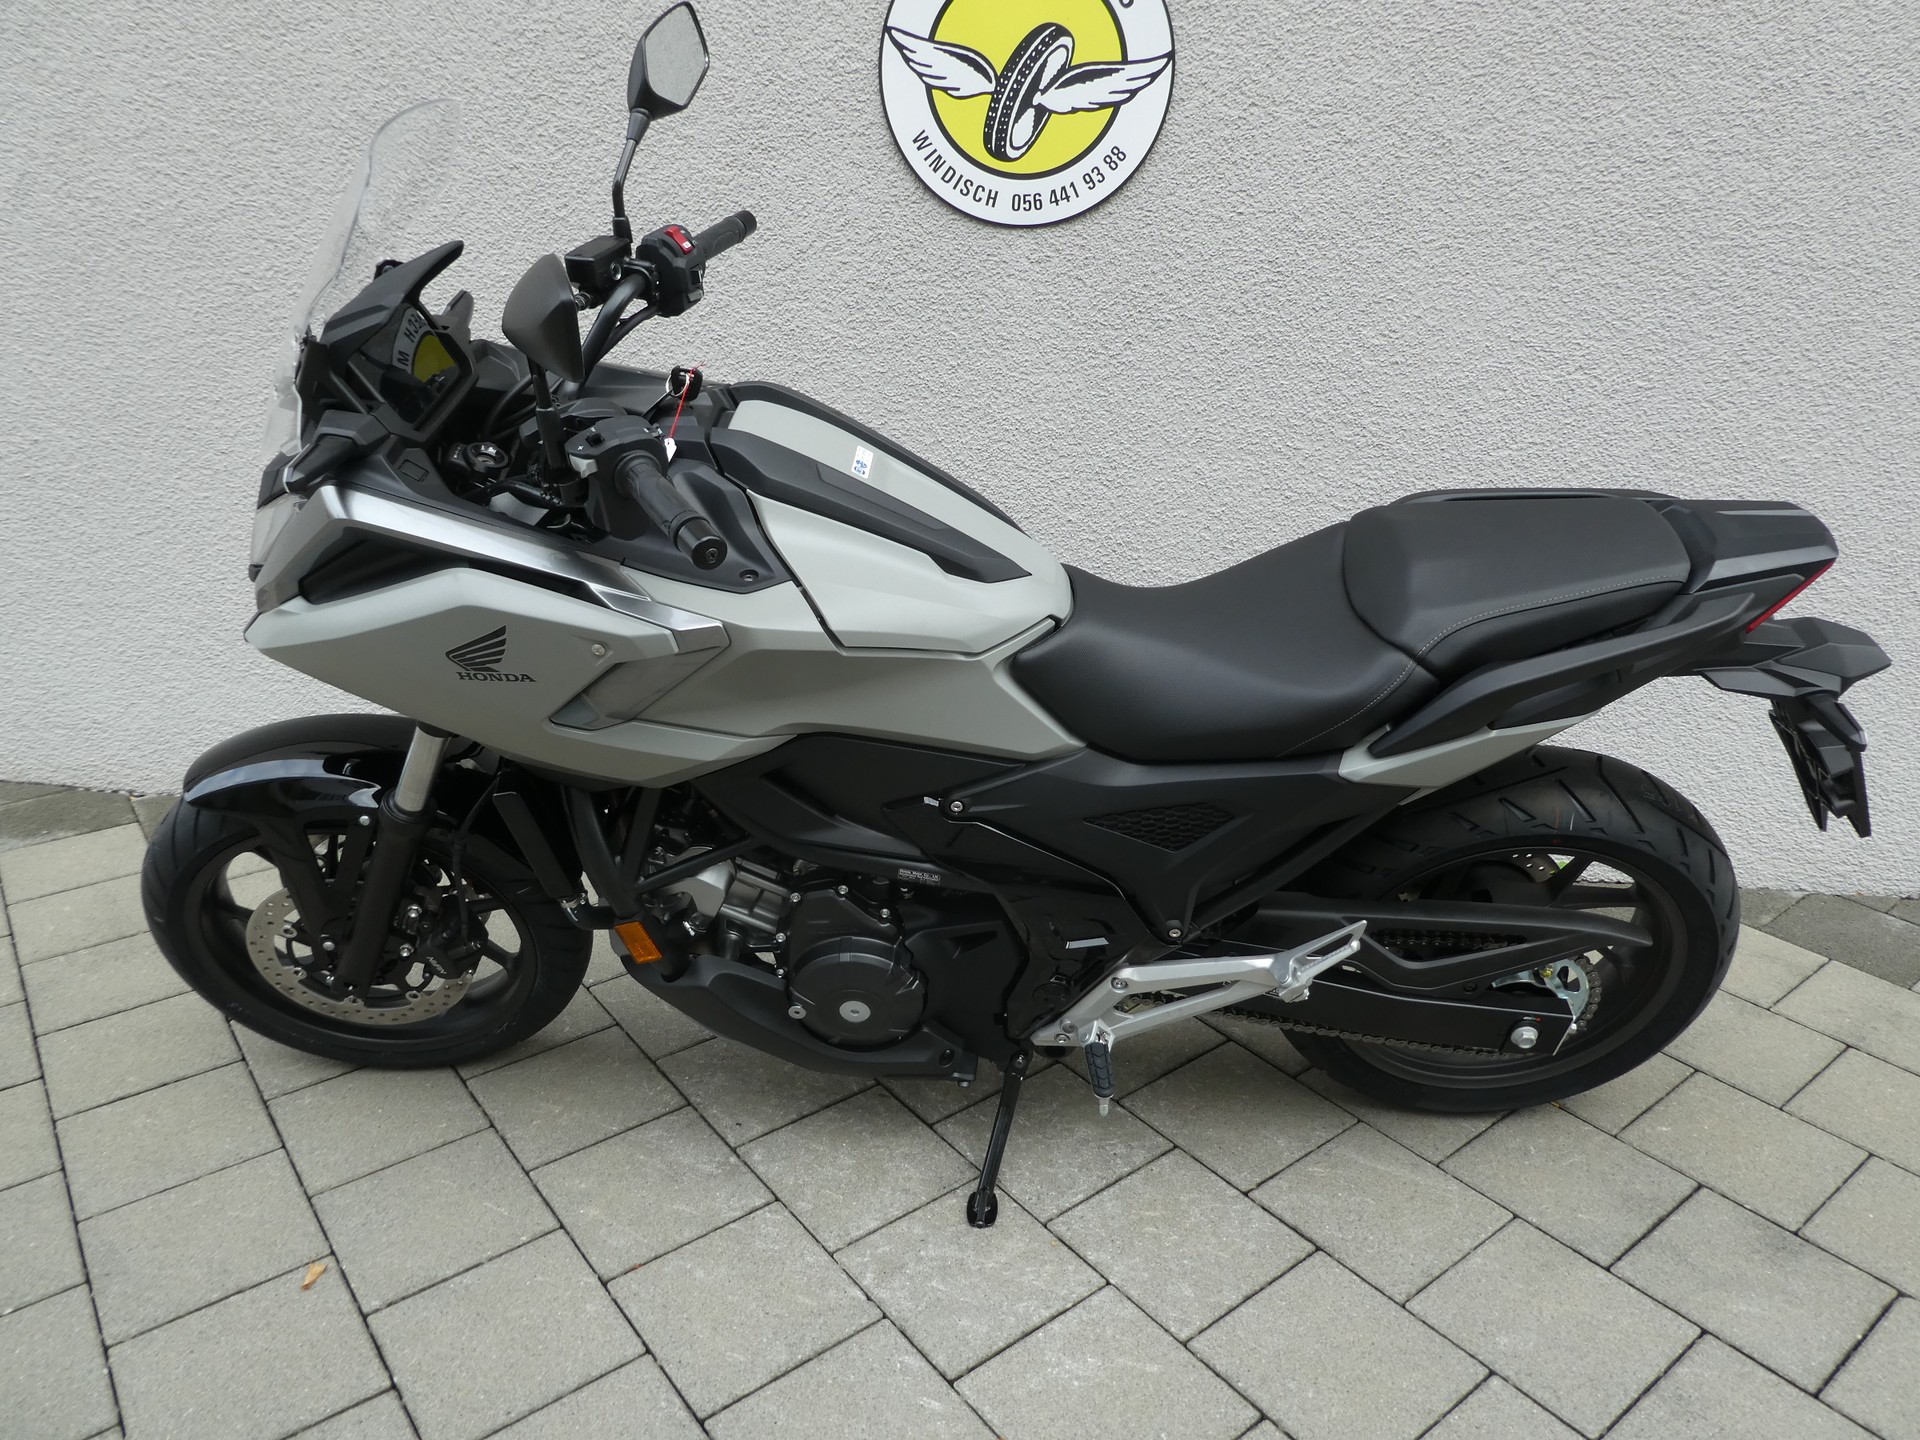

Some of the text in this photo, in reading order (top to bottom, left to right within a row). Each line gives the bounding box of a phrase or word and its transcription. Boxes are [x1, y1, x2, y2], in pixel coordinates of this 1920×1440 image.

[911, 129, 1127, 212] WINDISCH 056 441 93 88
[456, 672, 537, 682] HONDA
